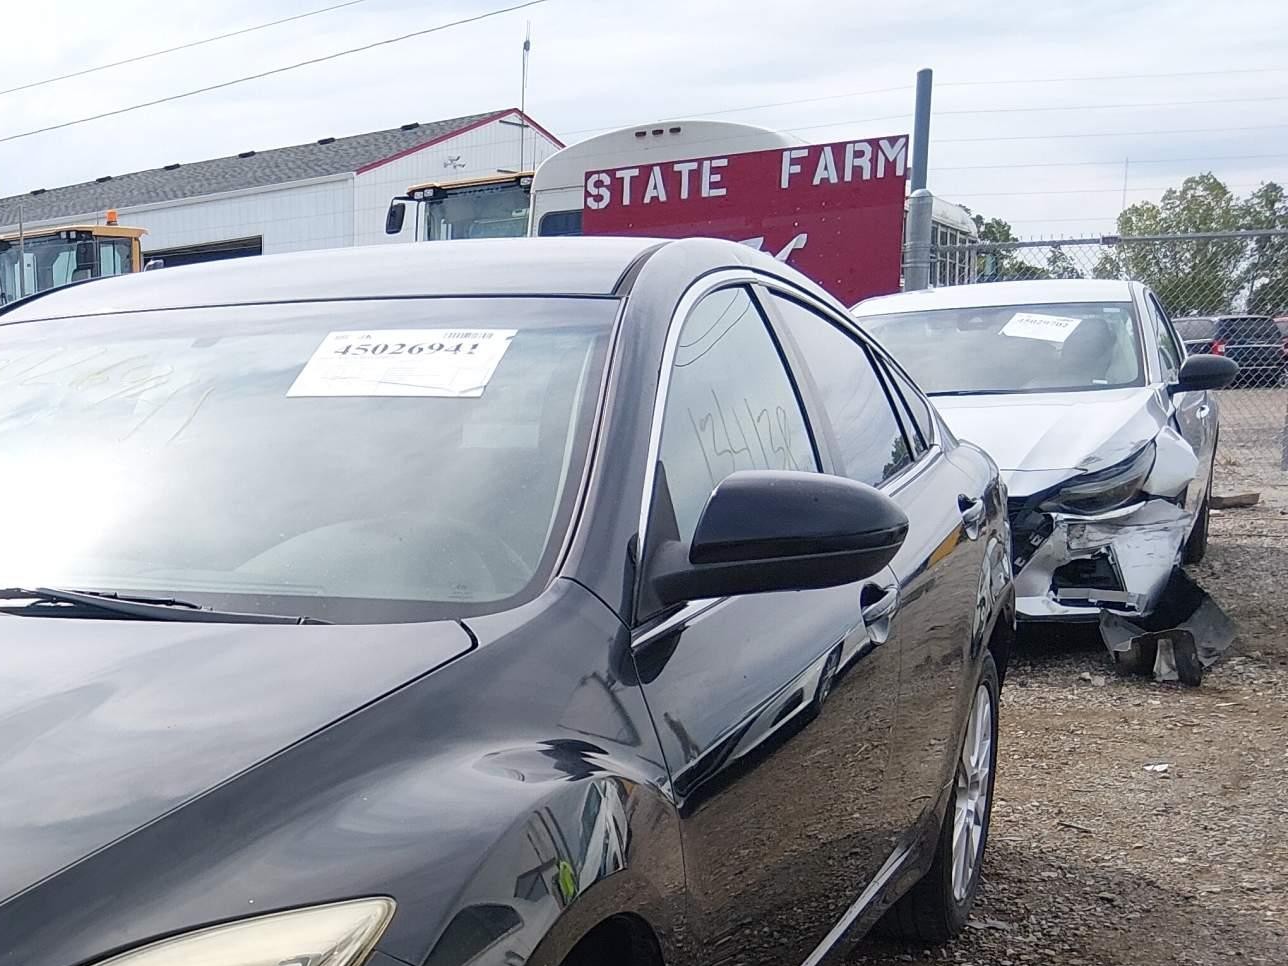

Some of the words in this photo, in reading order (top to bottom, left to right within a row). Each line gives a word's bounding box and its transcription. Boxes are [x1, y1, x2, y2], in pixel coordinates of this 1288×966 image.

[586, 158, 729, 210] STATE
[780, 137, 907, 189] FARM
[333, 341, 480, 357] 45026941
